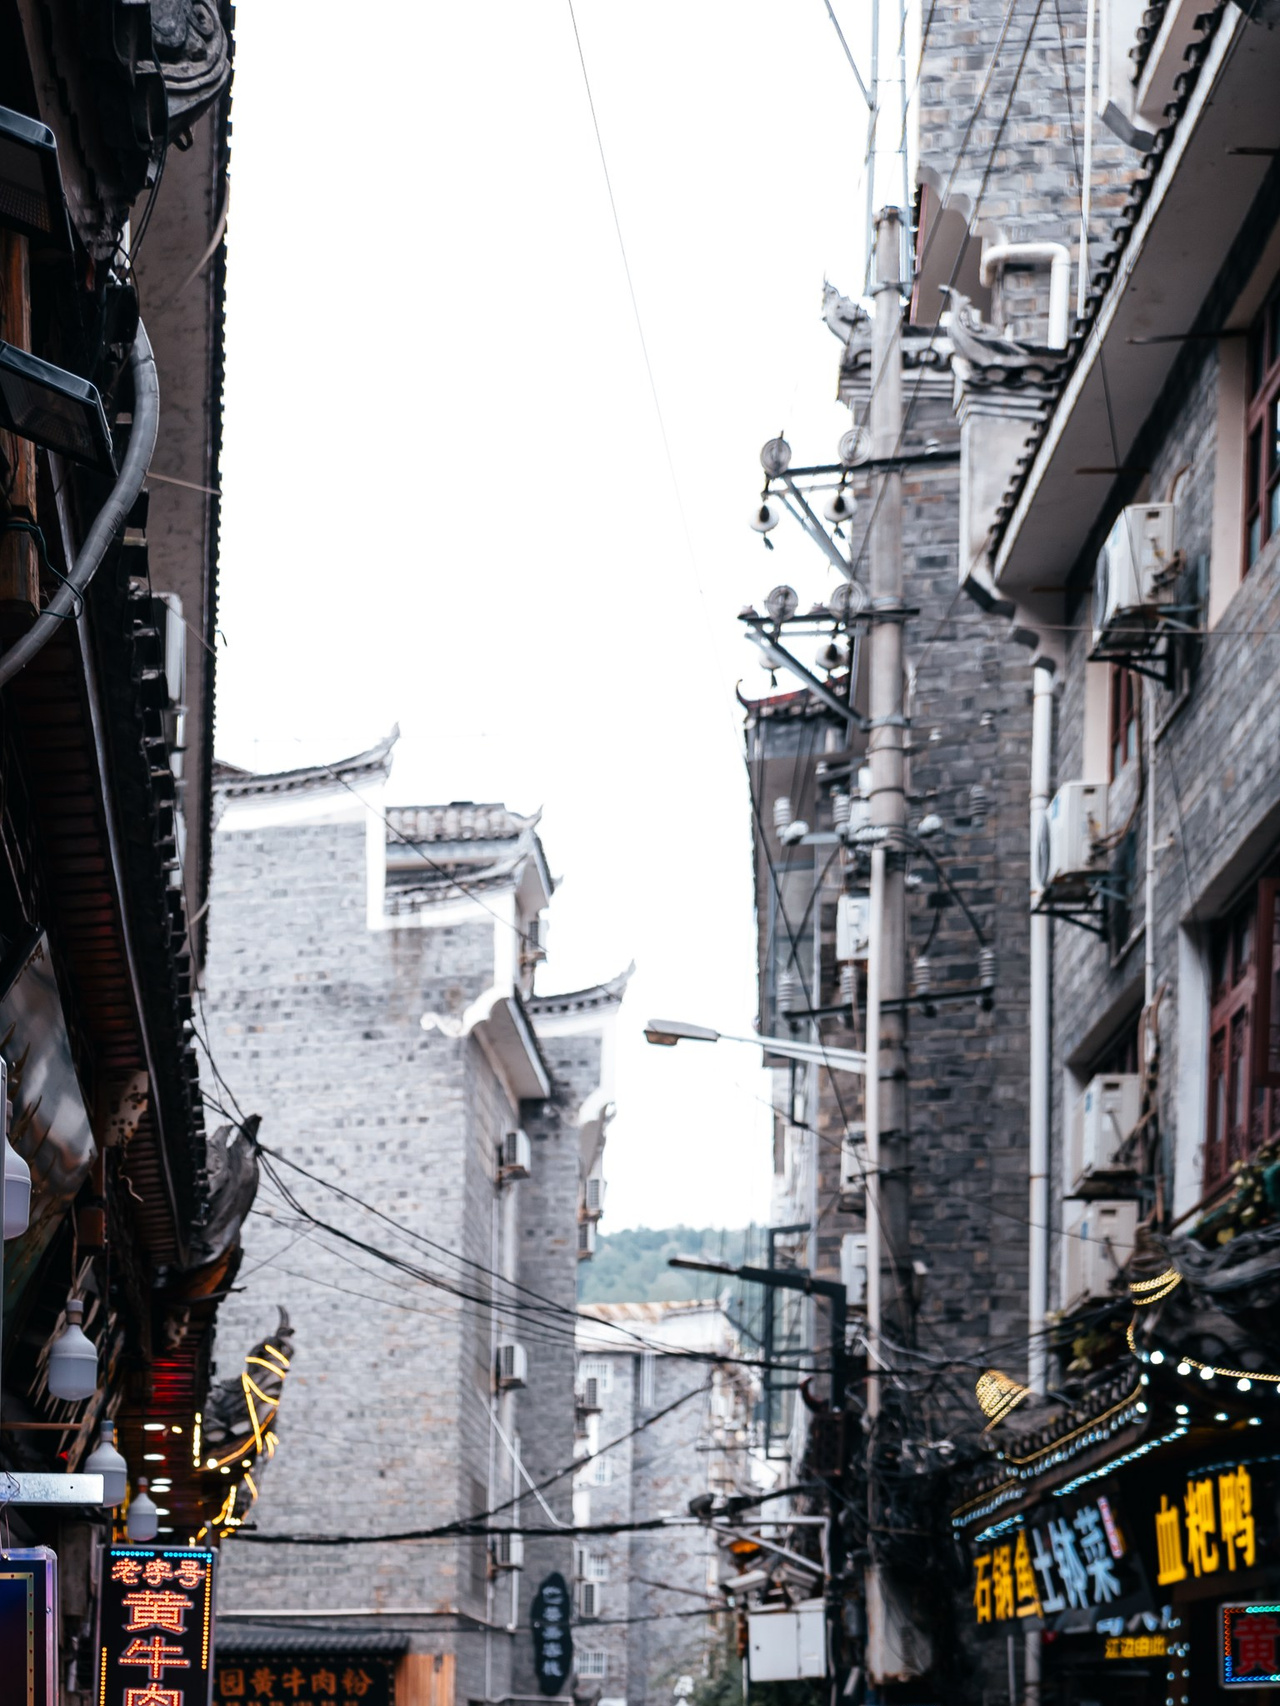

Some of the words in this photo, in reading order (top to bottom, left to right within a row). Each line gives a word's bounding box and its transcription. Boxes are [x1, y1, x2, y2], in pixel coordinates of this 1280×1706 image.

[1155, 1464, 1256, 1586] 血粑鸭
[111, 1557, 206, 1587] 老字号
[213, 1666, 373, 1697] 园黄牛肉粉
